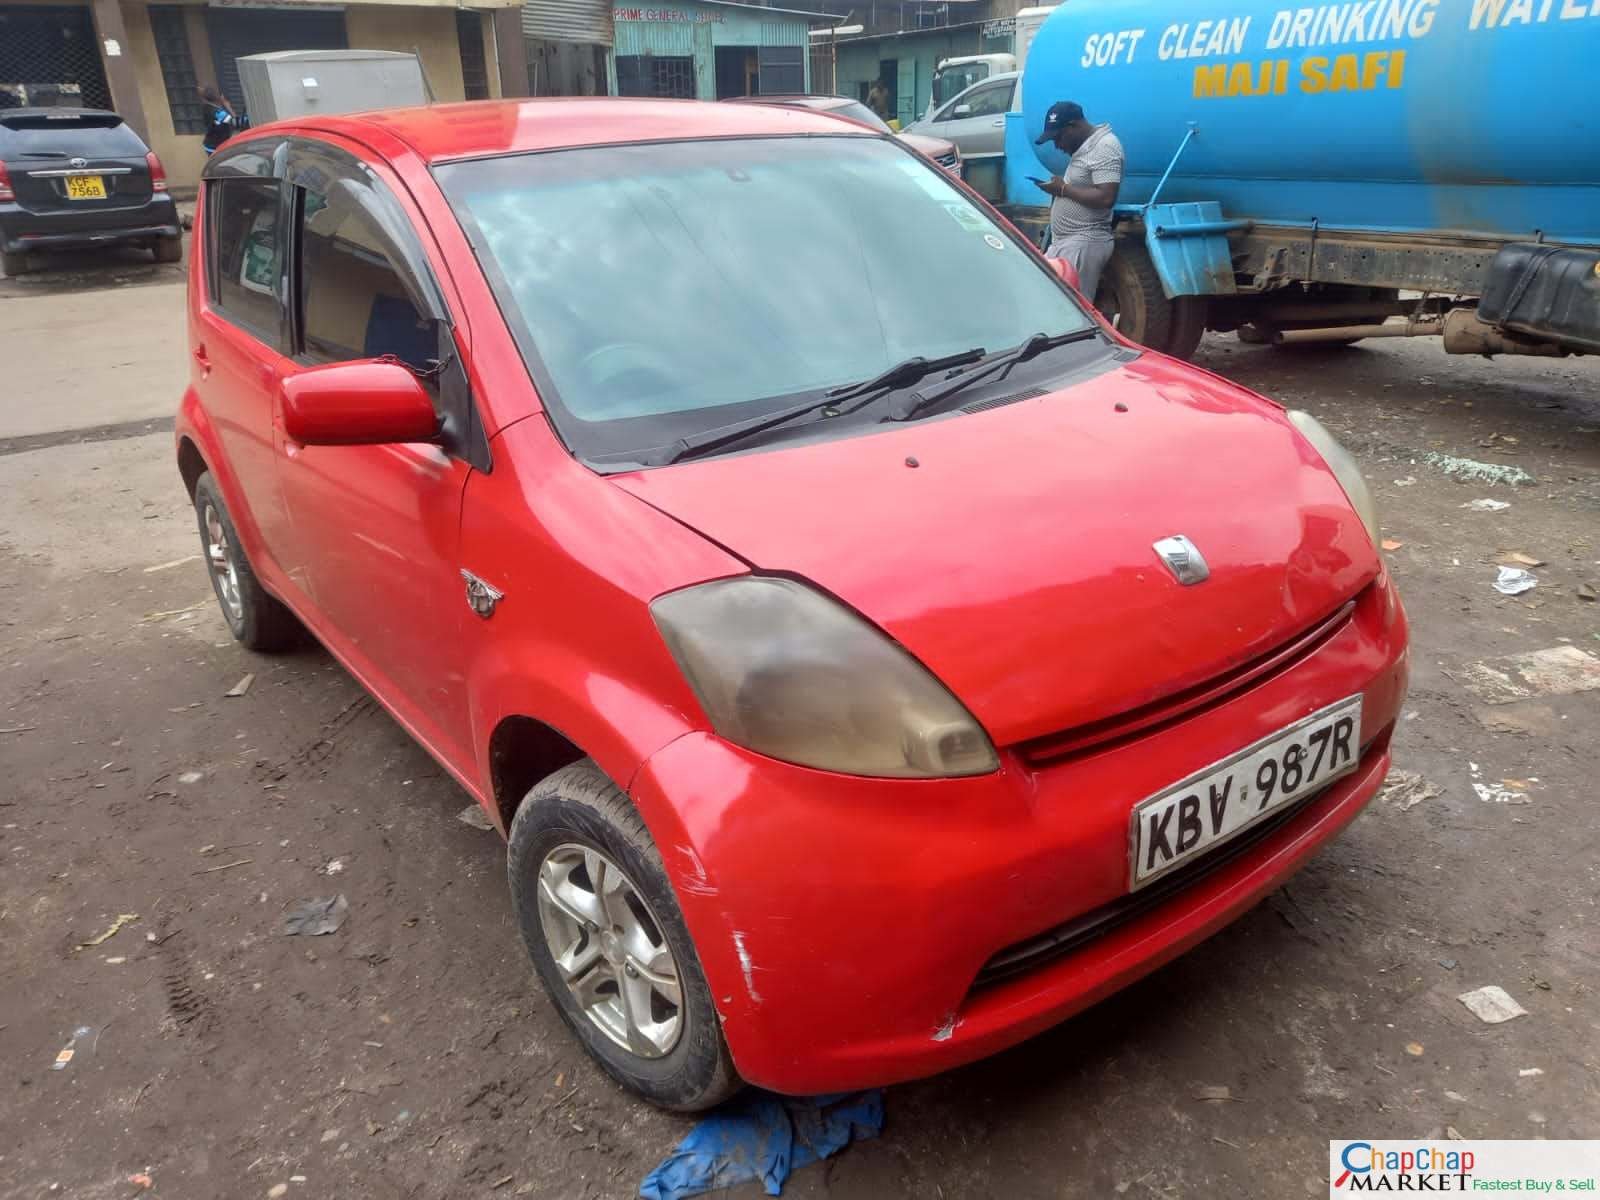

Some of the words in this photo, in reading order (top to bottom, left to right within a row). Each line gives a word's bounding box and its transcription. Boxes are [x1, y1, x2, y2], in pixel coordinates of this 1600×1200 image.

[614, 7, 644, 21] PRIME
[646, 8, 690, 22] GENERAL
[1081, 29, 1145, 68] SOFT
[1158, 16, 1251, 60] CLEAN
[1266, 0, 1440, 50] DRINKING
[1193, 60, 1289, 98] MAJI
[1301, 50, 1406, 93] SAFI
[1147, 775, 1233, 870] KBV
[1256, 716, 1354, 810] 987R
